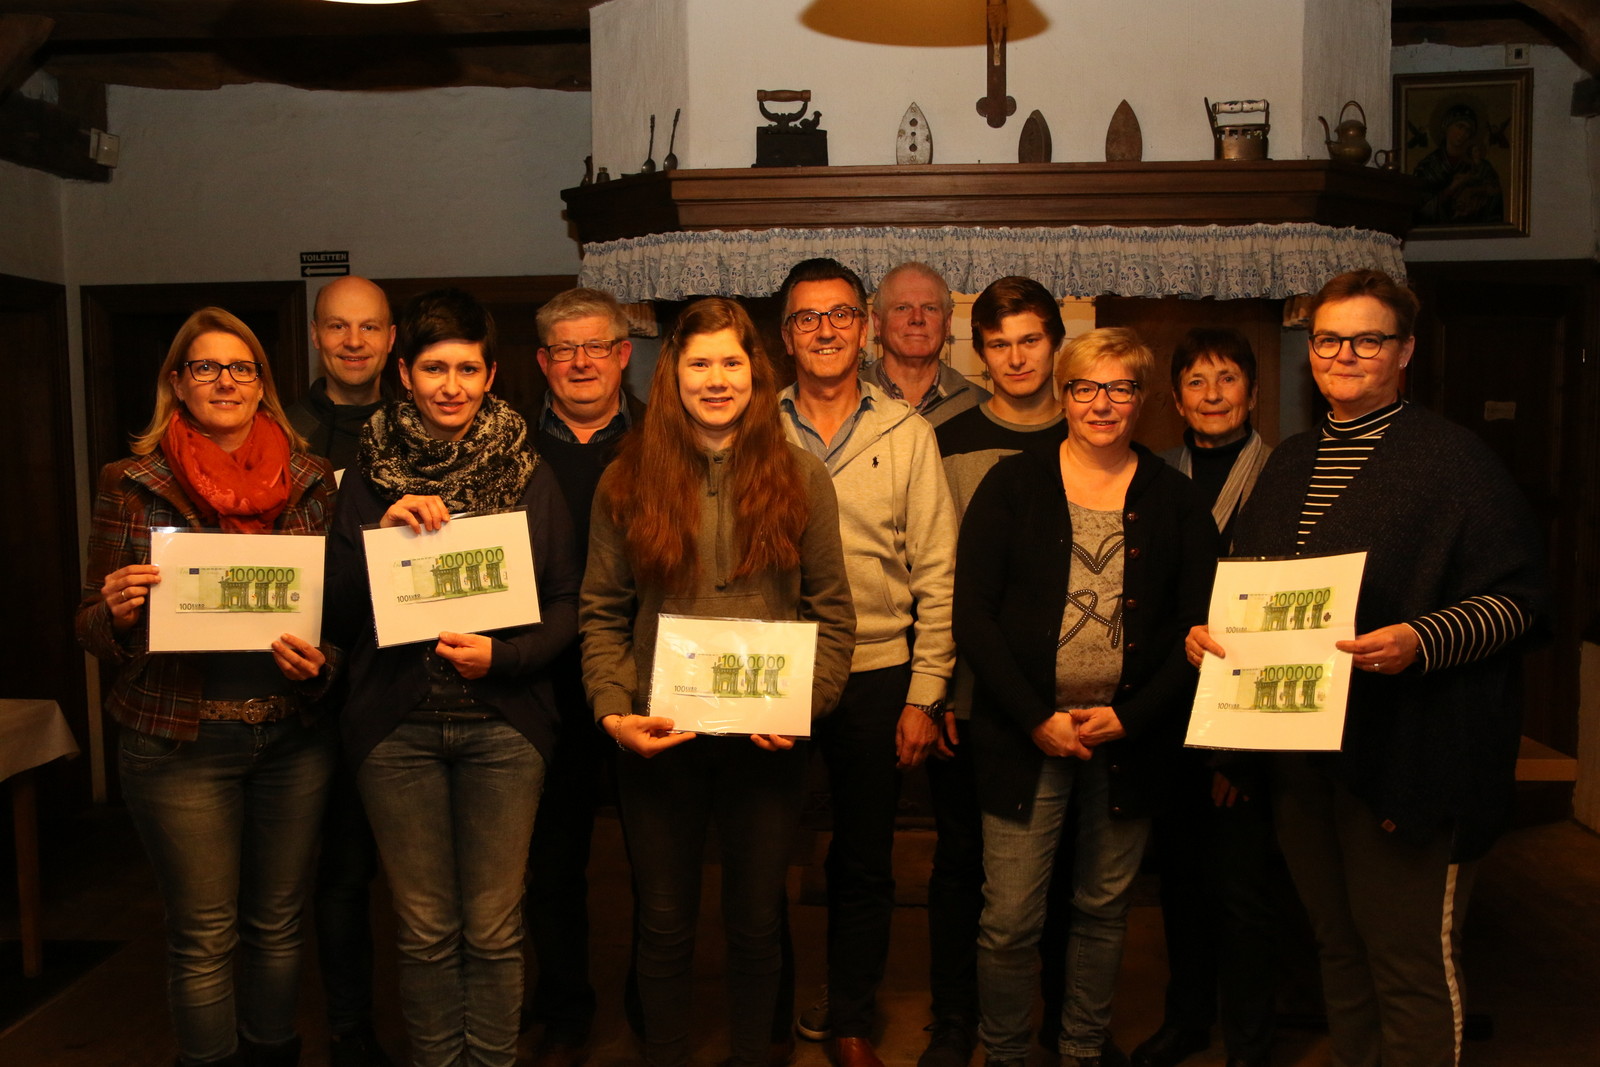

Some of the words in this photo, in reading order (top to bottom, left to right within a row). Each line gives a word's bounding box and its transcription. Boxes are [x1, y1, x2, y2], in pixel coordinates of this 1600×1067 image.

[302, 253, 346, 262] TOILETTEN
[439, 548, 504, 568] 1000000
[230, 567, 296, 583] 1000000
[1274, 588, 1331, 606] 1000000
[1263, 665, 1324, 682] 1000000
